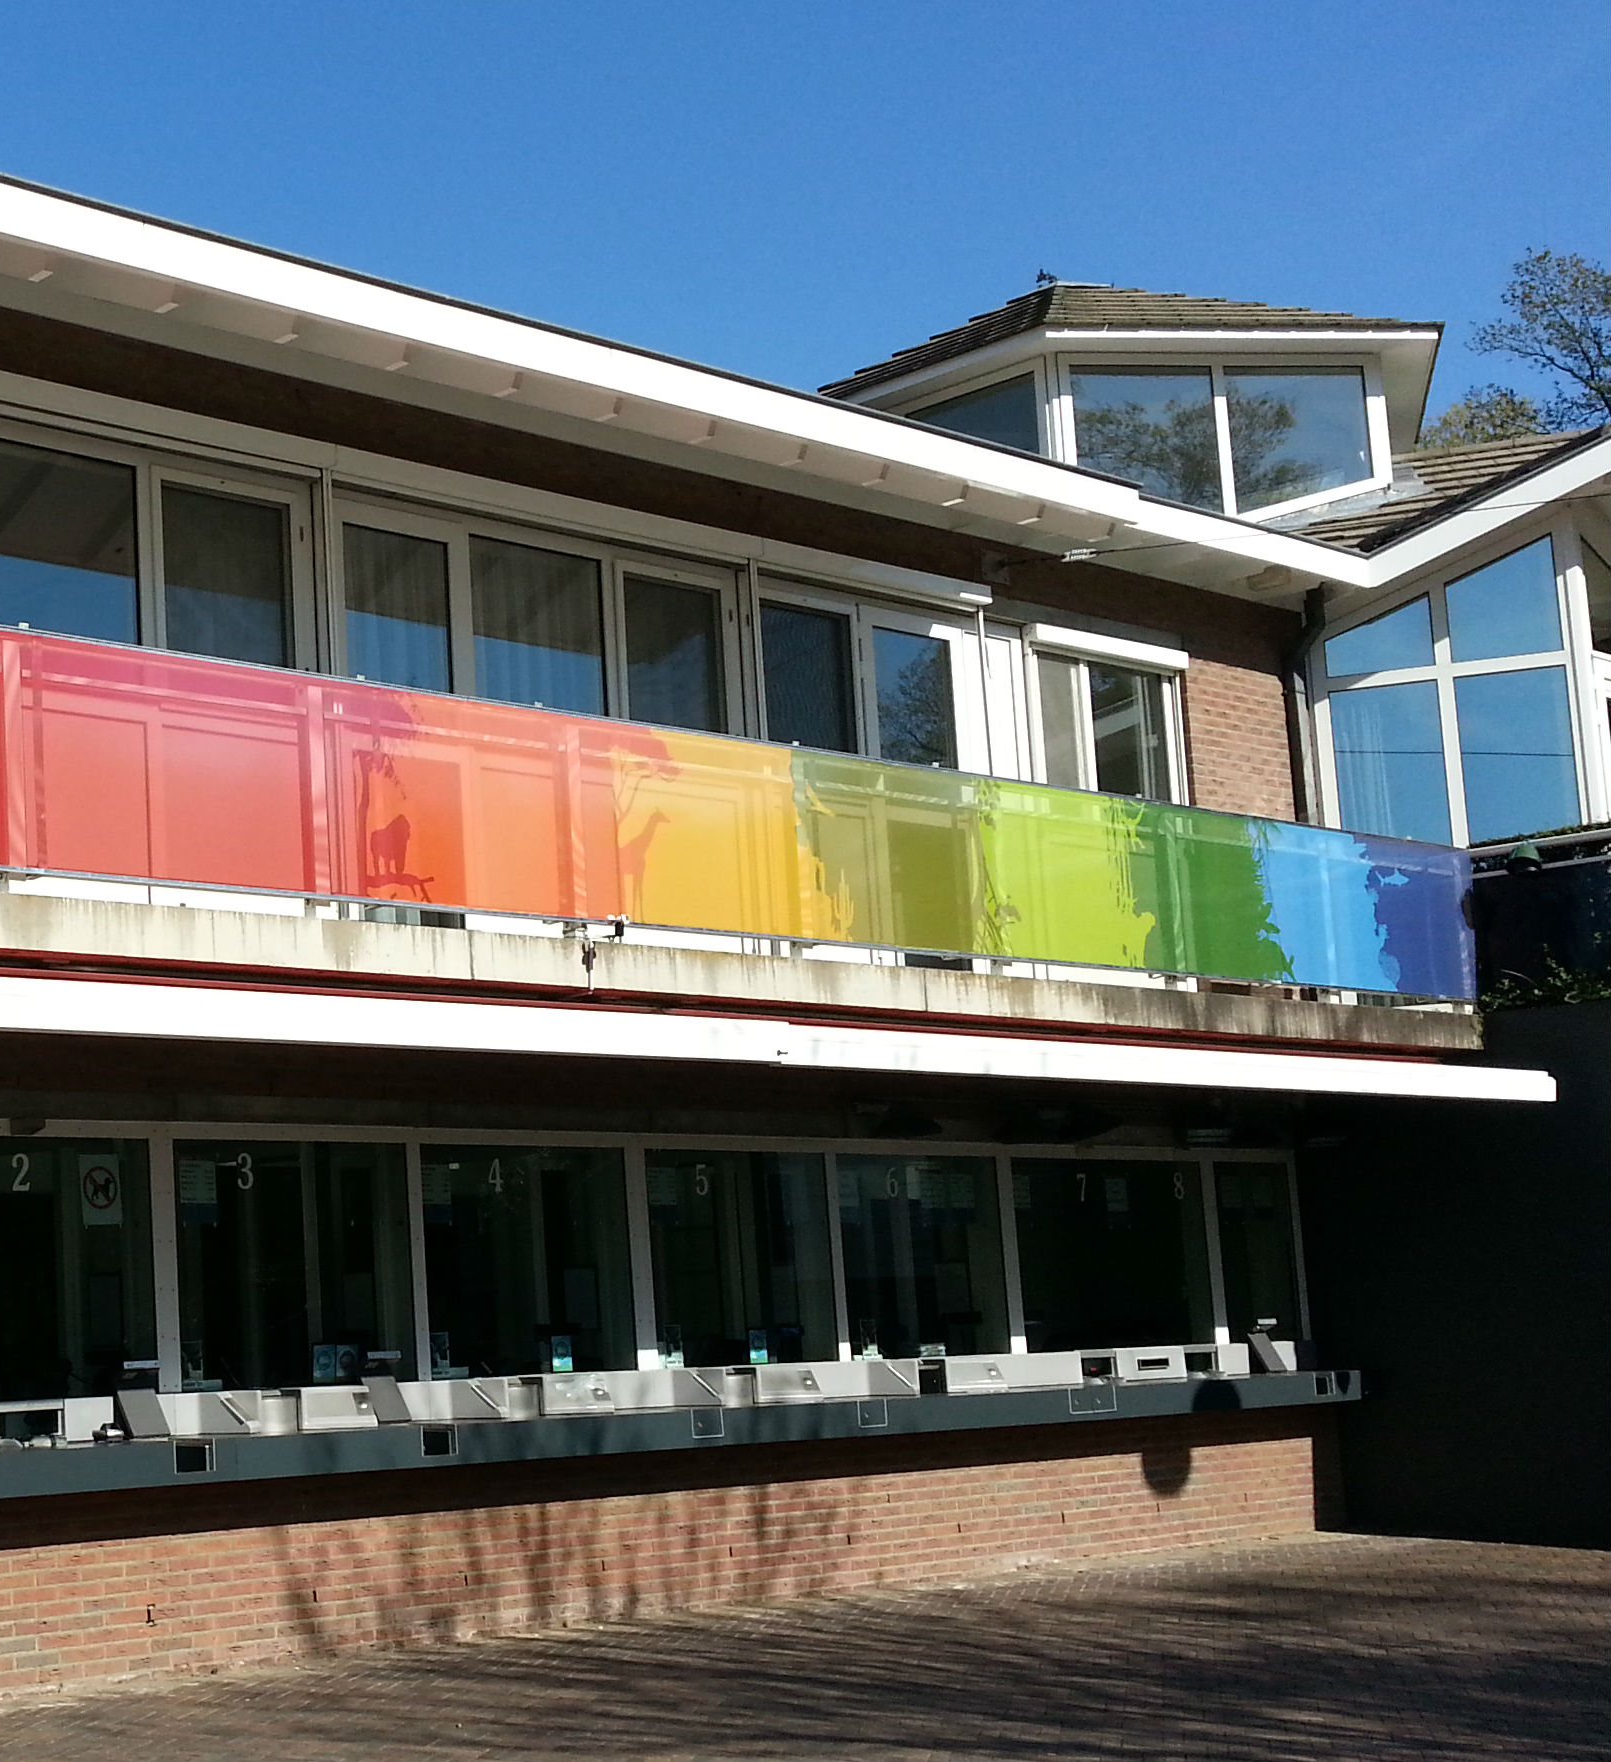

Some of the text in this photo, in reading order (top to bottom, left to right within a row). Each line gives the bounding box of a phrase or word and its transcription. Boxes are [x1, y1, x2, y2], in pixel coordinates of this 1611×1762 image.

[11, 1153, 31, 1192] 2
[236, 1153, 254, 1190] 3
[487, 1158, 504, 1194] 4
[694, 1163, 709, 1196] 5
[886, 1167, 899, 1198] 6
[1076, 1173, 1087, 1203] 7
[1173, 1172, 1186, 1201] 8
